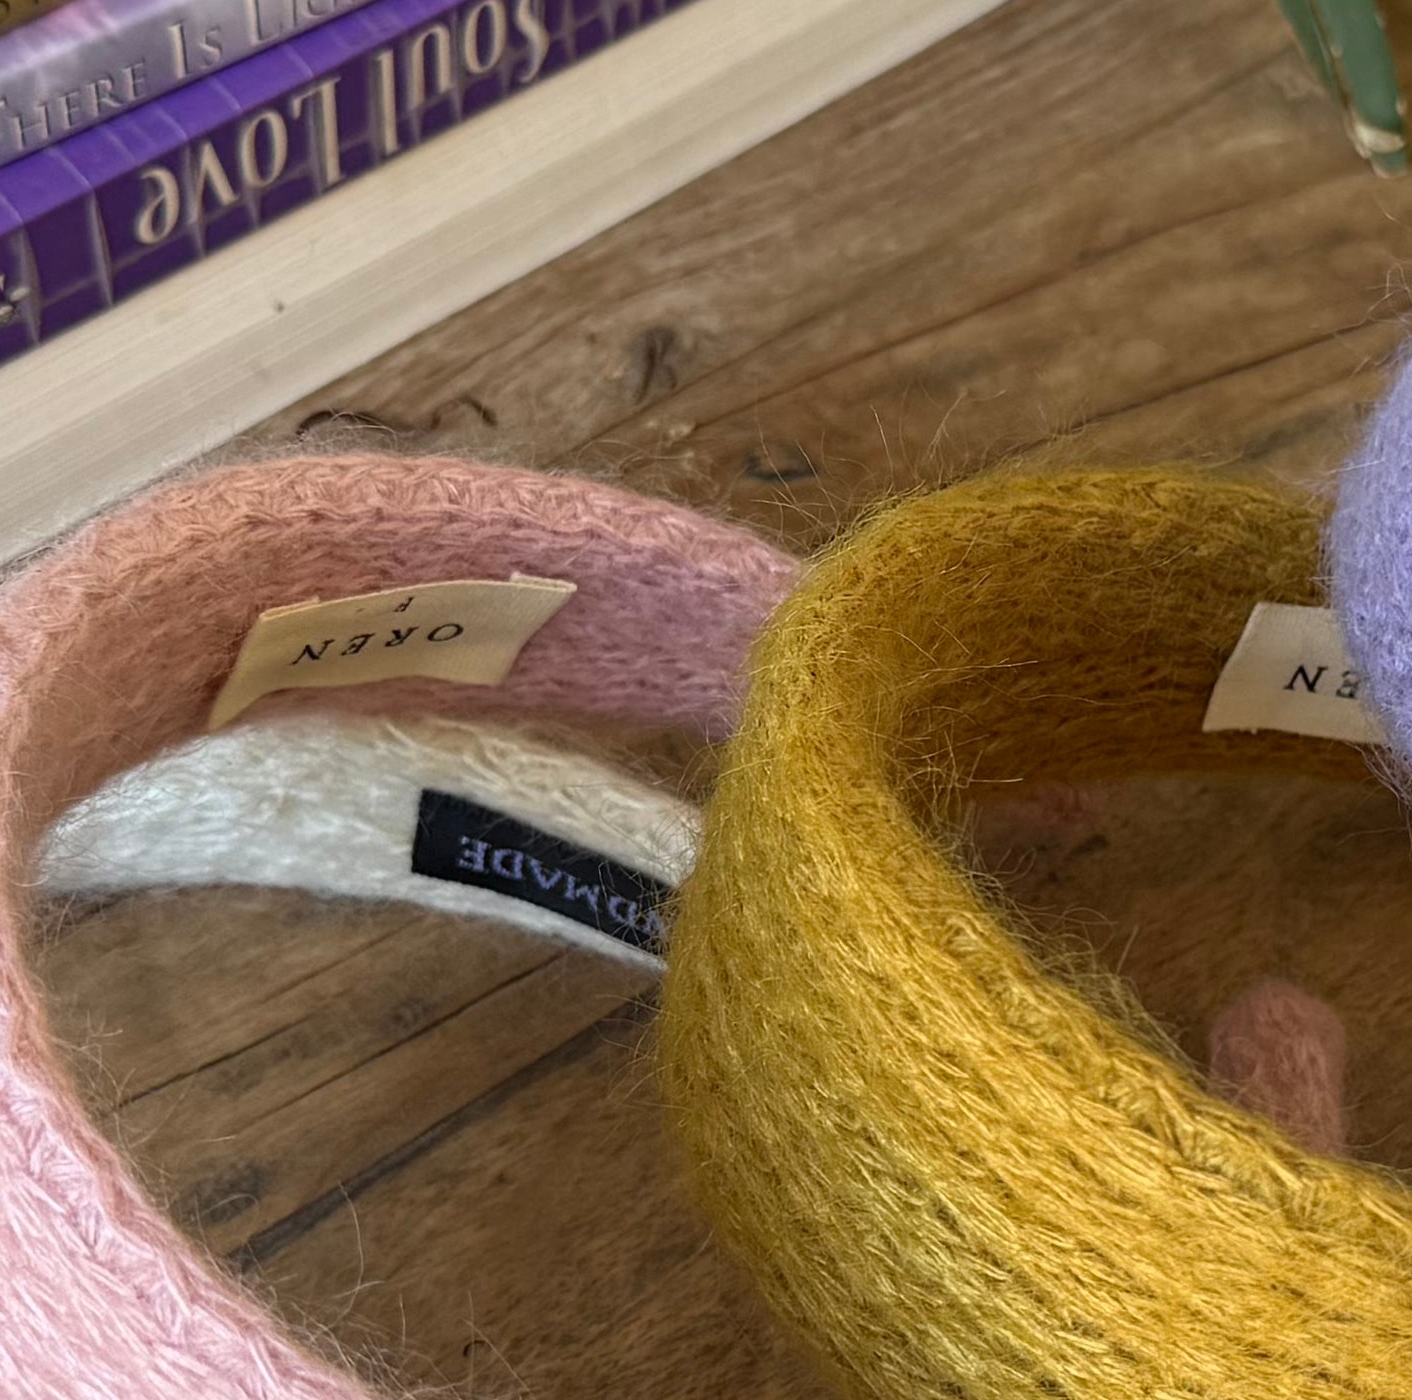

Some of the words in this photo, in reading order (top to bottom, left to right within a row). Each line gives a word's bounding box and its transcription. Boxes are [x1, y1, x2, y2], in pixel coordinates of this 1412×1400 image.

[132, 75, 343, 246] Love
[292, 622, 464, 667] OREN
[1283, 663, 1366, 701] EN
